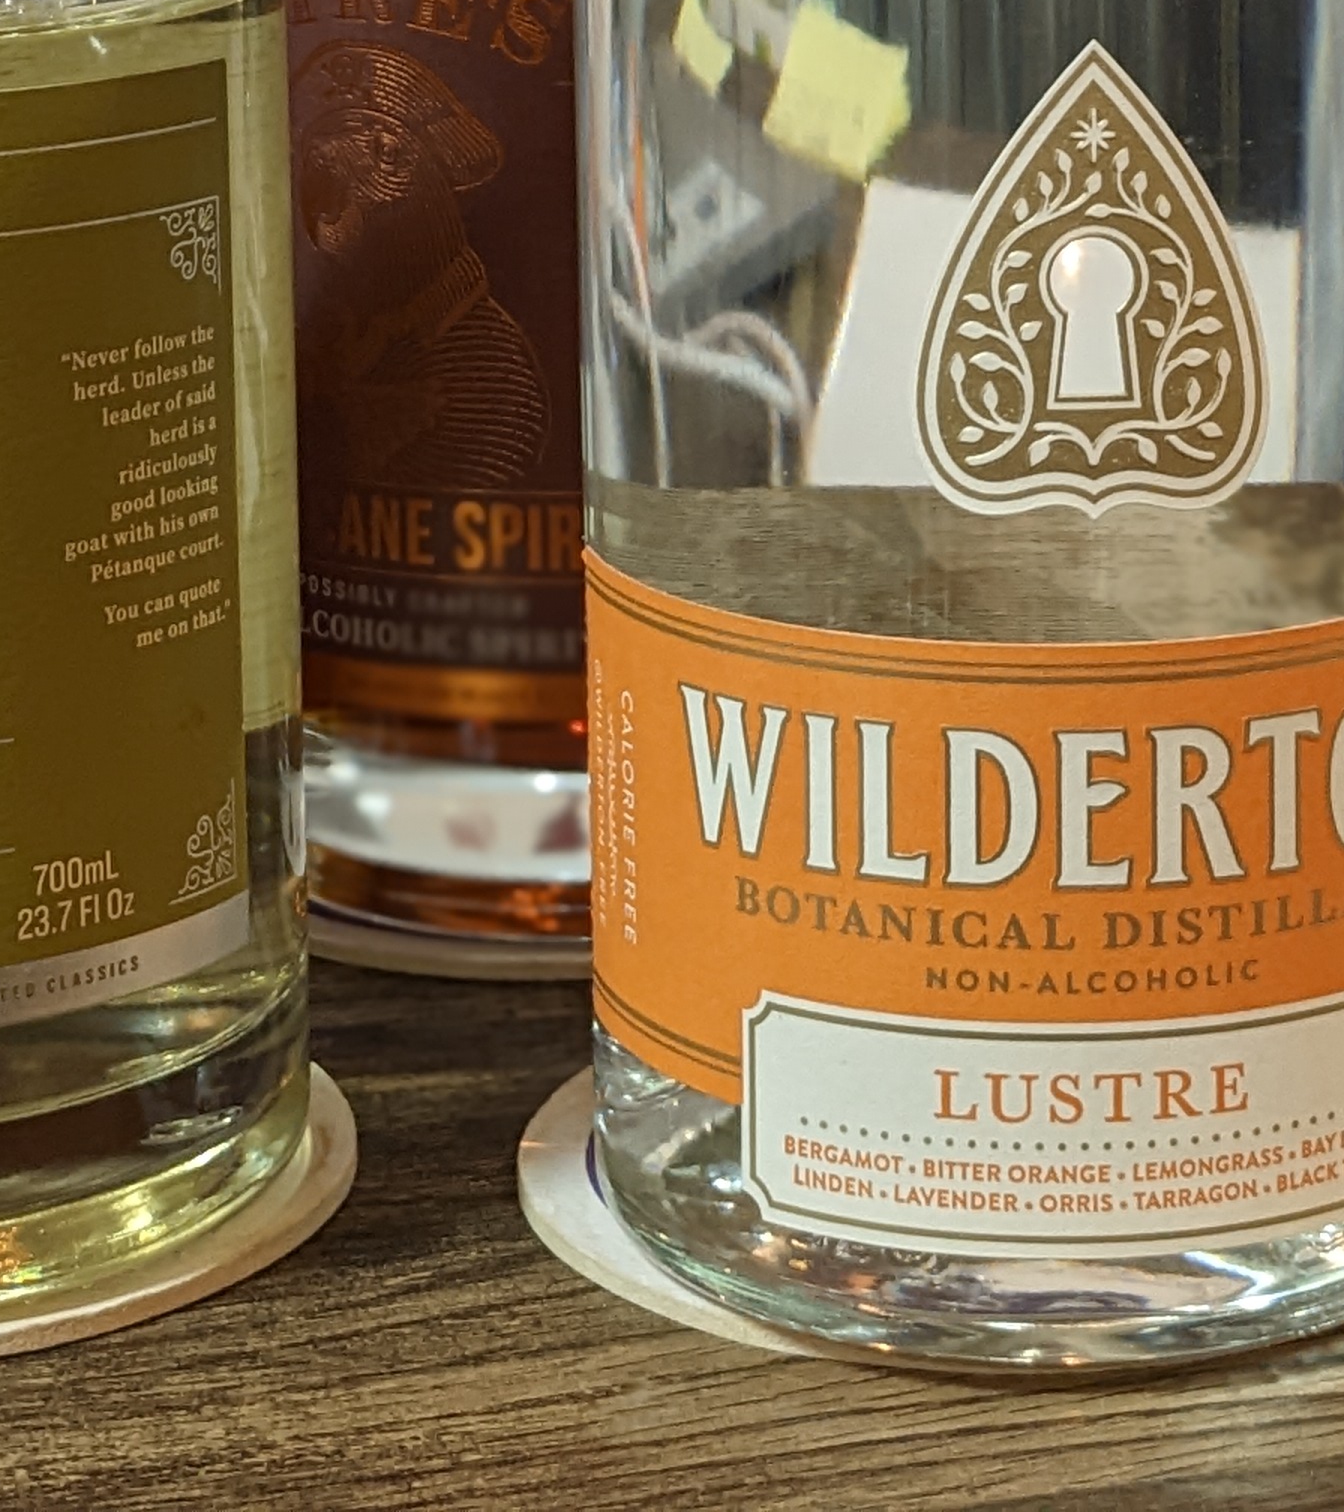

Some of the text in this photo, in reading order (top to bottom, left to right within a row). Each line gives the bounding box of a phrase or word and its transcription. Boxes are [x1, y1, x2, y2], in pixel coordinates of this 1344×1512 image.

[133, 333, 188, 360] follow
[191, 325, 215, 346] the
[73, 355, 216, 402] herd. Unless the
[102, 382, 217, 428] leader of said
[149, 418, 217, 448] herd is a
[118, 443, 218, 486] ridiculously
[110, 474, 219, 522] good looking
[64, 505, 220, 562] goat with his own
[338, 492, 583, 571] ANE SPIR
[91, 537, 224, 584] Pétanque court.
[104, 577, 221, 627] You can quote
[136, 628, 164, 649] me
[168, 619, 189, 640] on
[619, 690, 639, 946] CALORIE FREE
[32, 850, 119, 897] 700mL
[17, 888, 136, 941] 23.7 Fl Oz
[735, 875, 1076, 952] BOTANICAL
[46, 955, 140, 994] CLASSICS
[925, 958, 1260, 995] NON-ALCOHOLIC
[933, 1061, 1249, 1124] LUSTRE
[783, 1134, 904, 1175] BERGAMOT
[923, 1157, 1002, 1184] BITTER
[1007, 1164, 1112, 1185] ORANGE
[1132, 1145, 1284, 1182] LEMONGRASS
[1301, 1137, 1337, 1160] BAY
[793, 1163, 874, 1199] LINDEN
[894, 1183, 1019, 1213] LAVENDER
[1039, 1193, 1114, 1214] ORRIS
[1133, 1178, 1258, 1211] TARRAGON
[1276, 1159, 1339, 1194] BLACK
